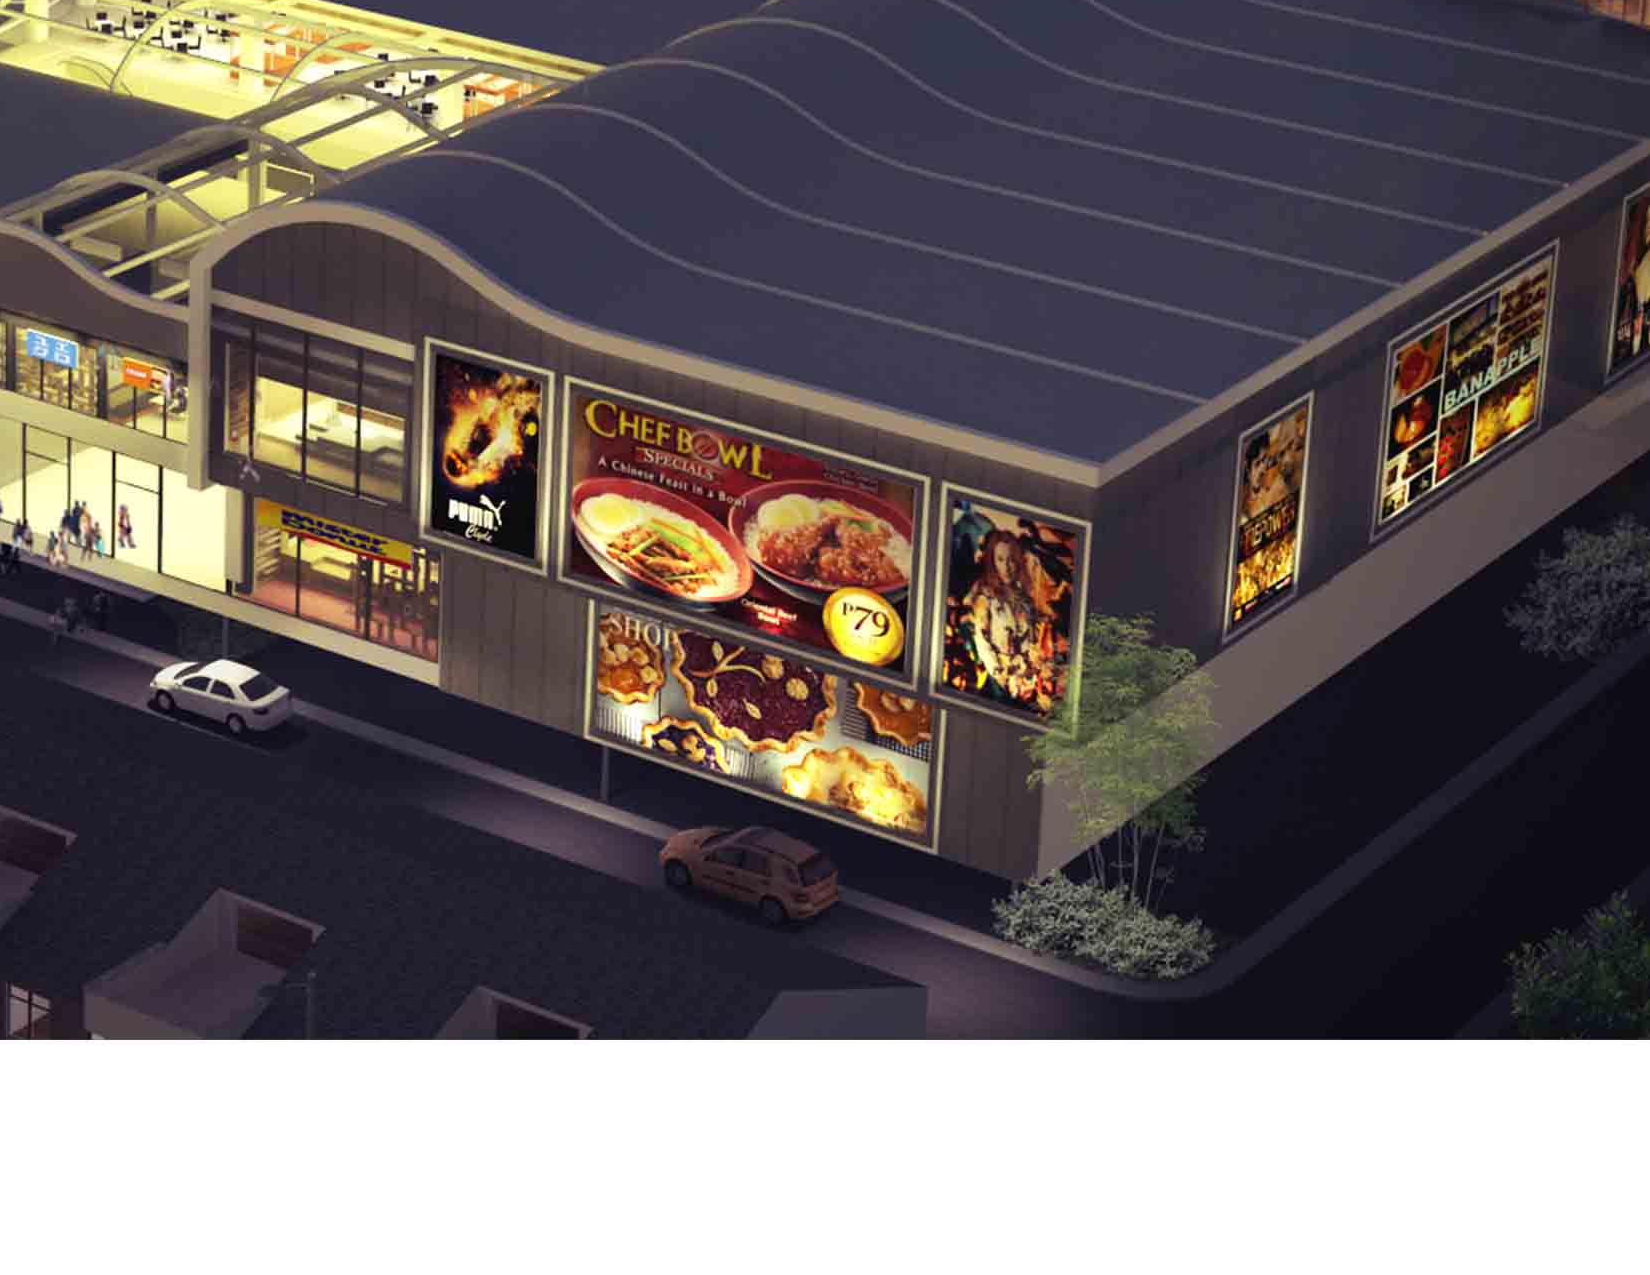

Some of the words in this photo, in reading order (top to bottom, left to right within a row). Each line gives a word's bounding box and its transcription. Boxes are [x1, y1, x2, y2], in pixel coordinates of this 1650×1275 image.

[1444, 330, 1544, 409] BANAPPLE
[598, 457, 607, 467] A
[611, 460, 655, 482] Chinese
[659, 472, 688, 491] Feast
[691, 483, 704, 495] in
[705, 490, 714, 499] a
[718, 491, 748, 509] Bowl
[643, 449, 716, 482] SPECIALS
[447, 499, 495, 531] PUMA
